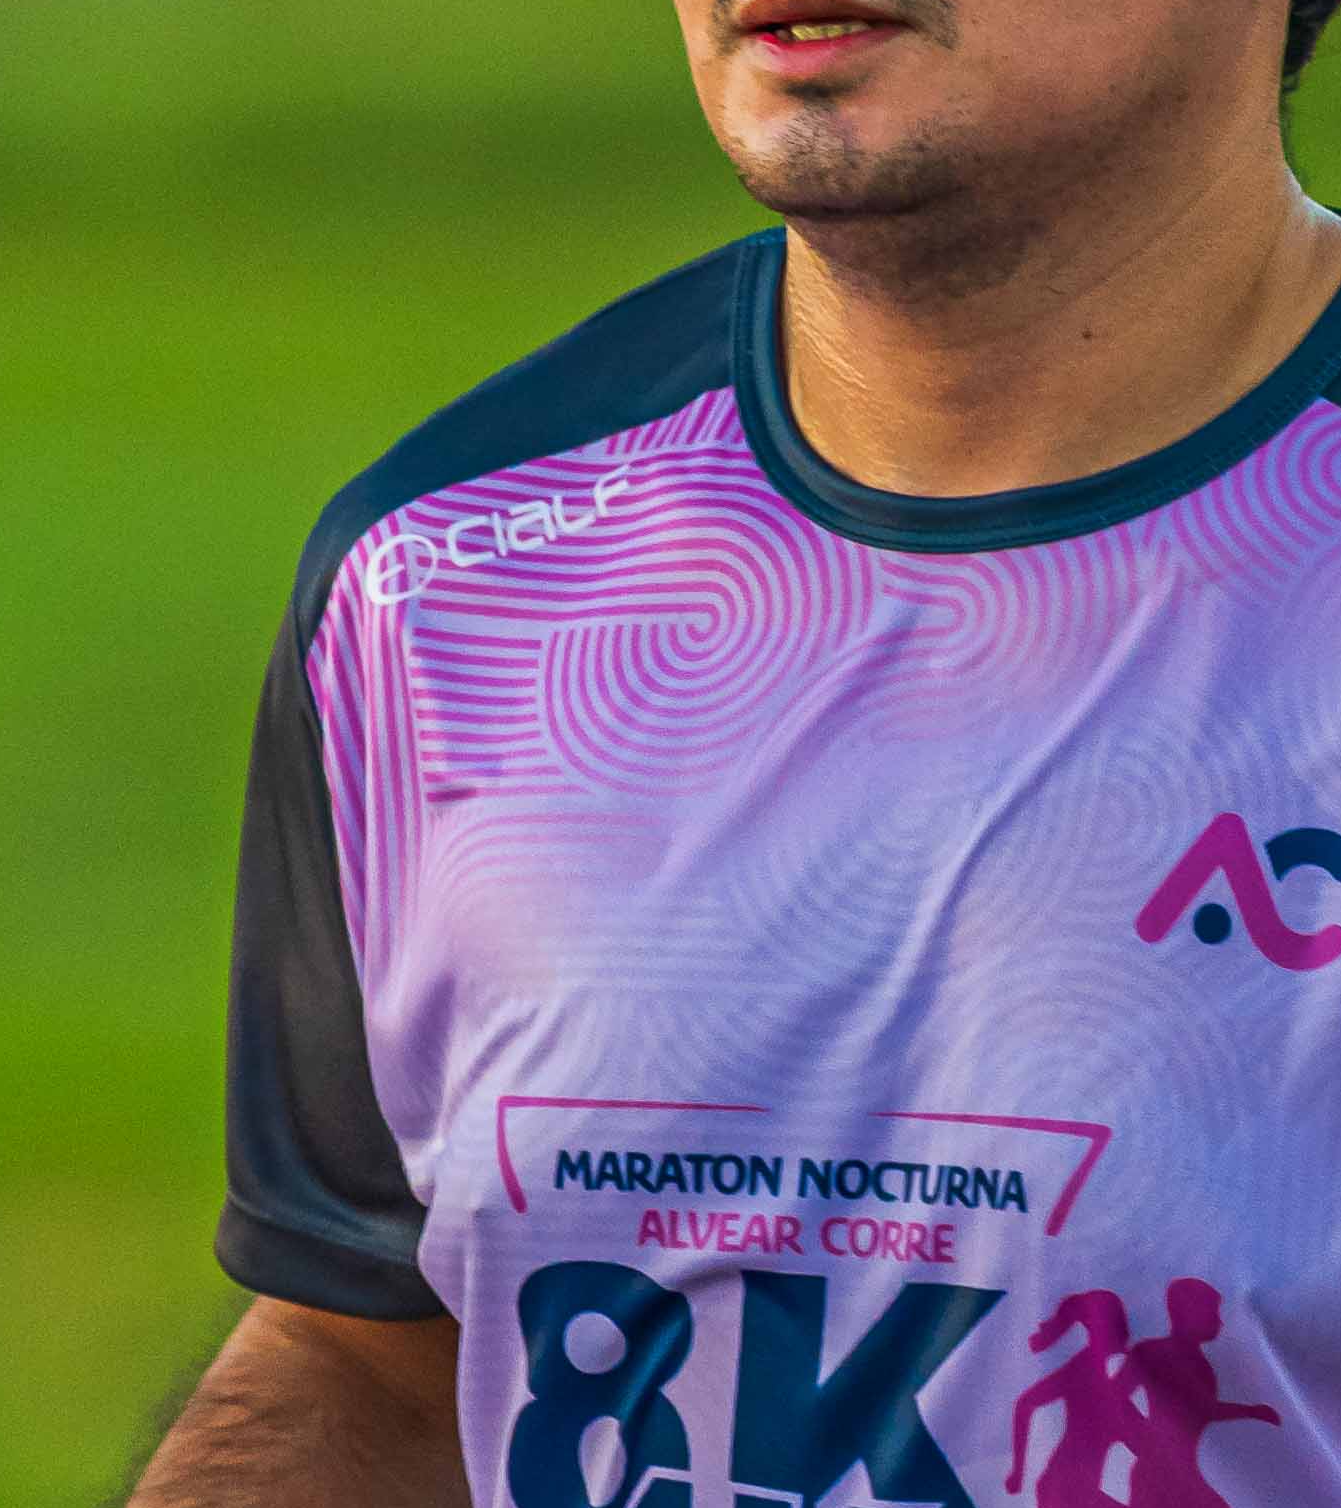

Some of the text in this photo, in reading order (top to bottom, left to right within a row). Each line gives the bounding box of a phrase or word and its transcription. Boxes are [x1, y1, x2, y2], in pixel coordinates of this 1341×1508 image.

[553, 1149, 1028, 1213] MARATON NOCTURNA
[636, 1209, 956, 1263] ALVEAR CORRE
